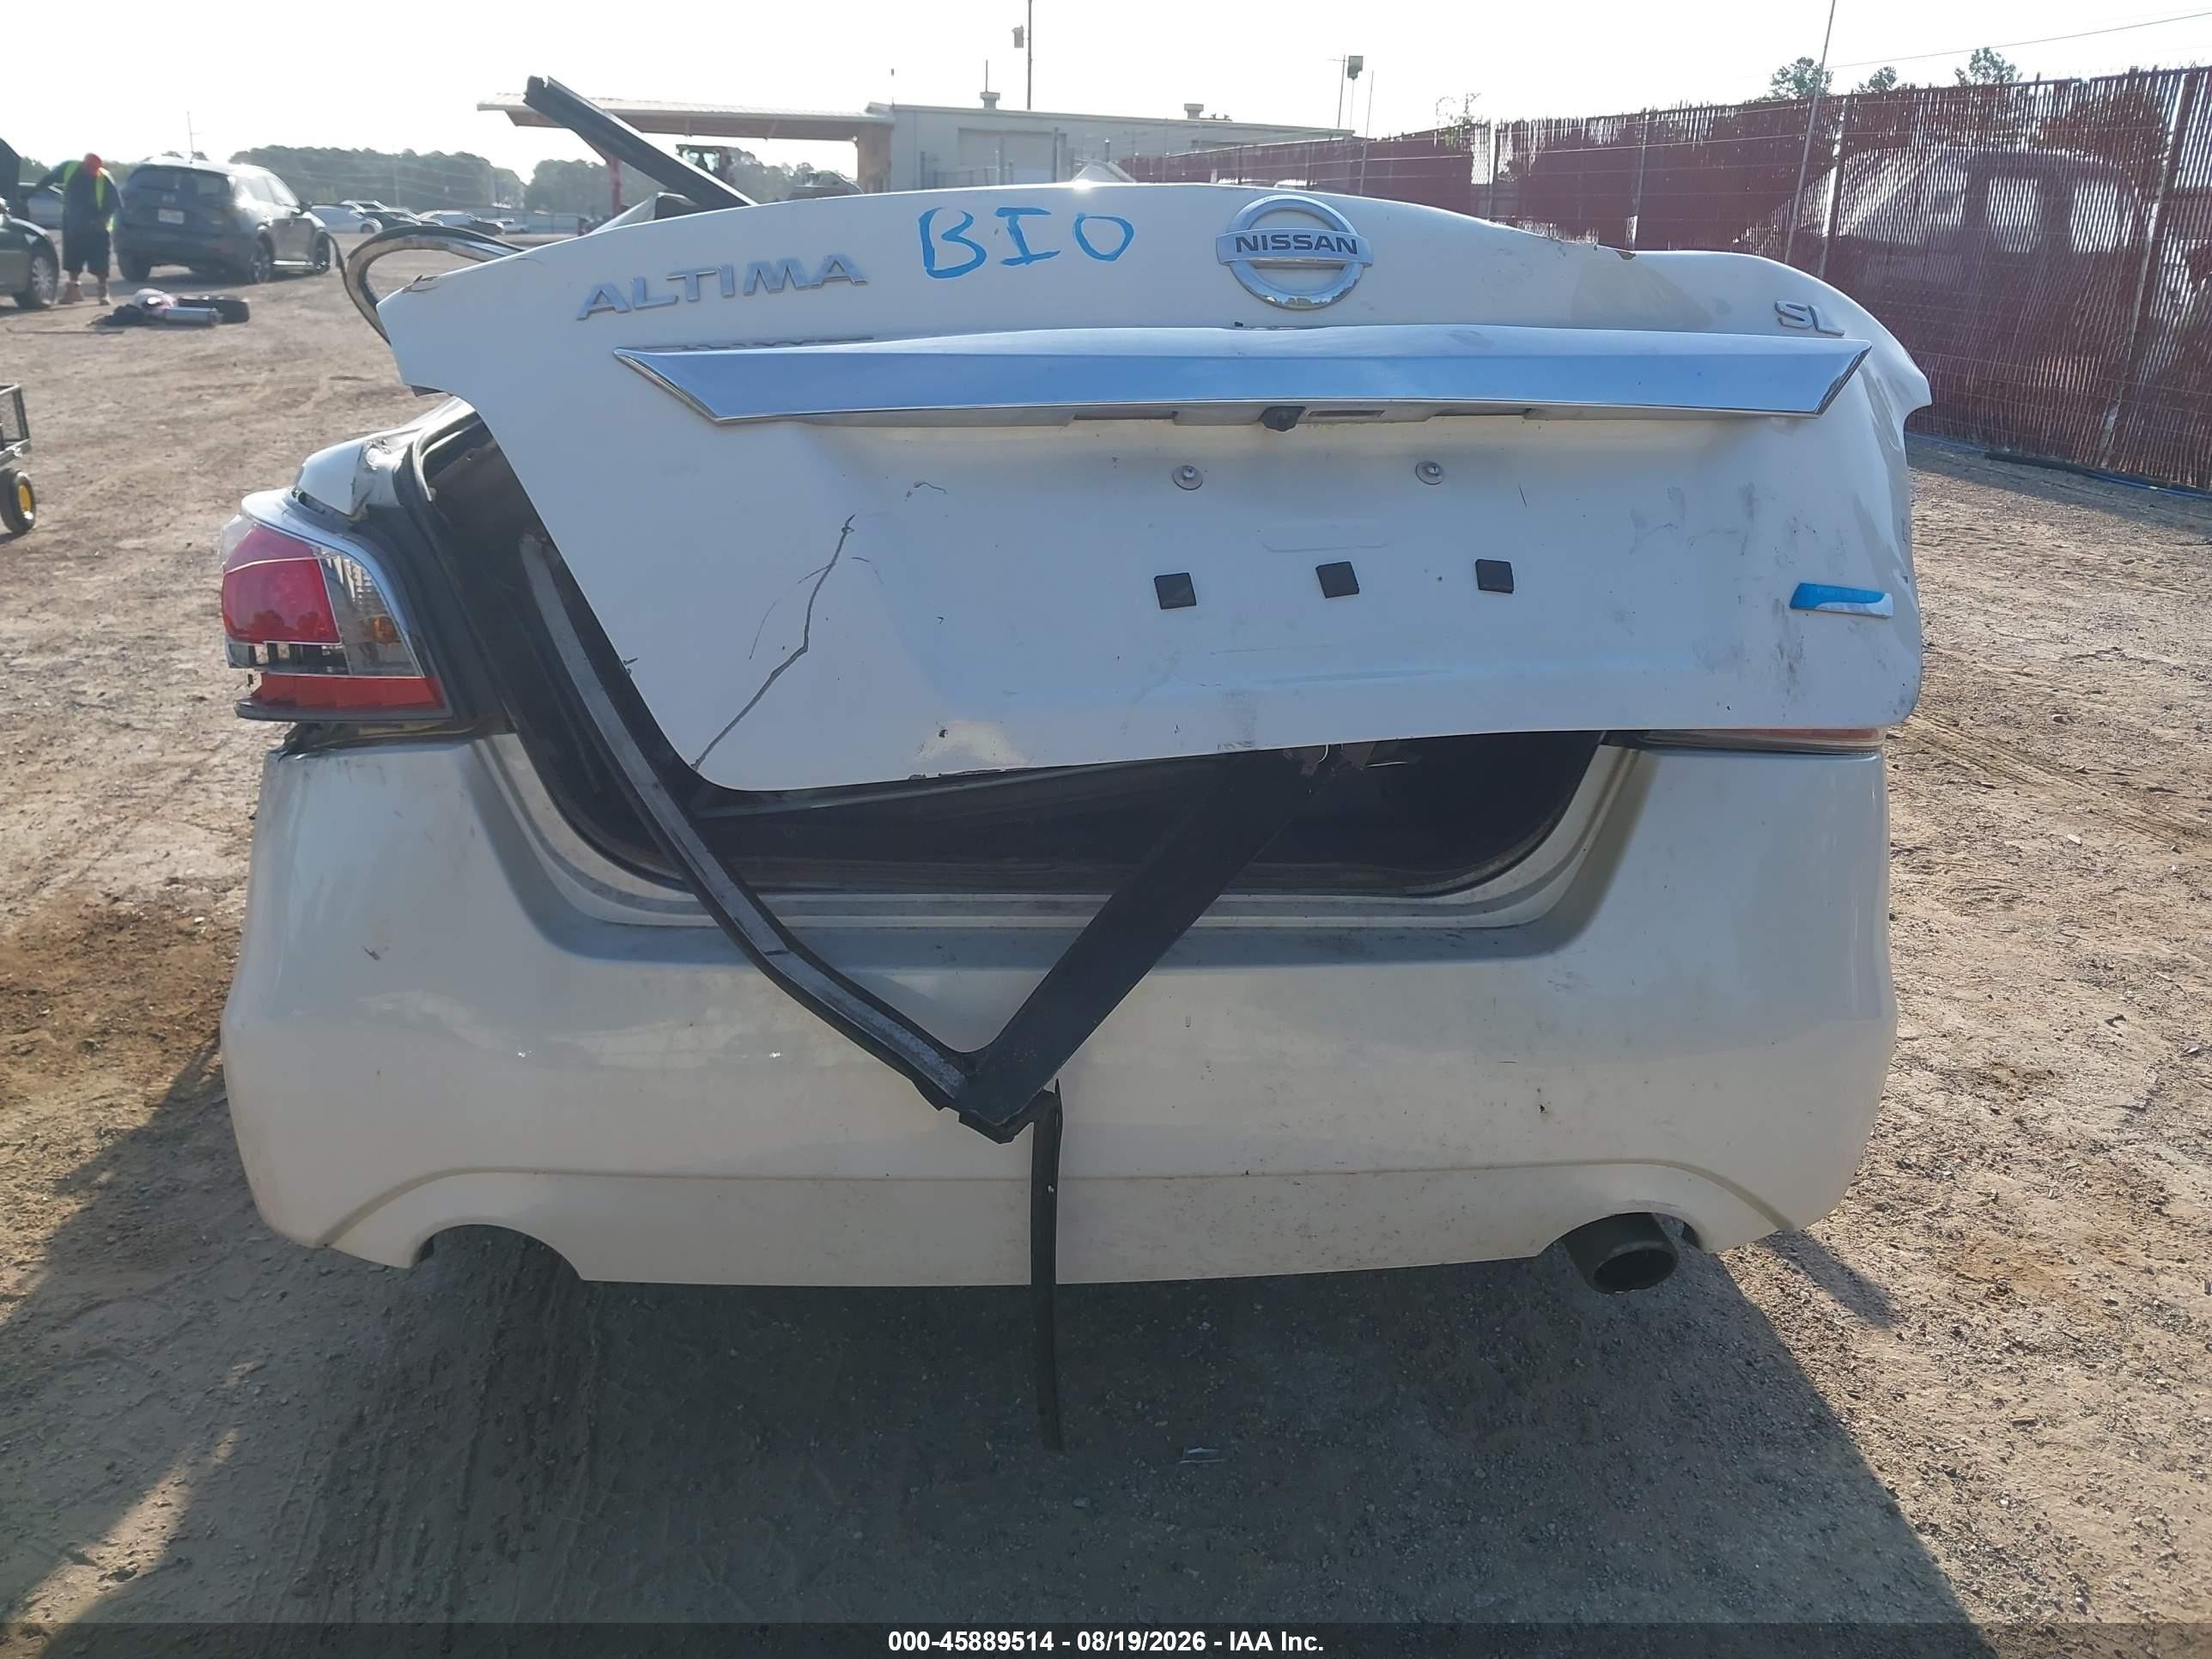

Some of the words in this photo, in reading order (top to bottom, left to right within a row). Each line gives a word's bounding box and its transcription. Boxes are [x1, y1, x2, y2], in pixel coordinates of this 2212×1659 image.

[919, 207, 1134, 279] BIO
[1235, 234, 1358, 255] NISSAN
[576, 254, 867, 321] ALTIMA
[1774, 301, 1845, 337] SL
